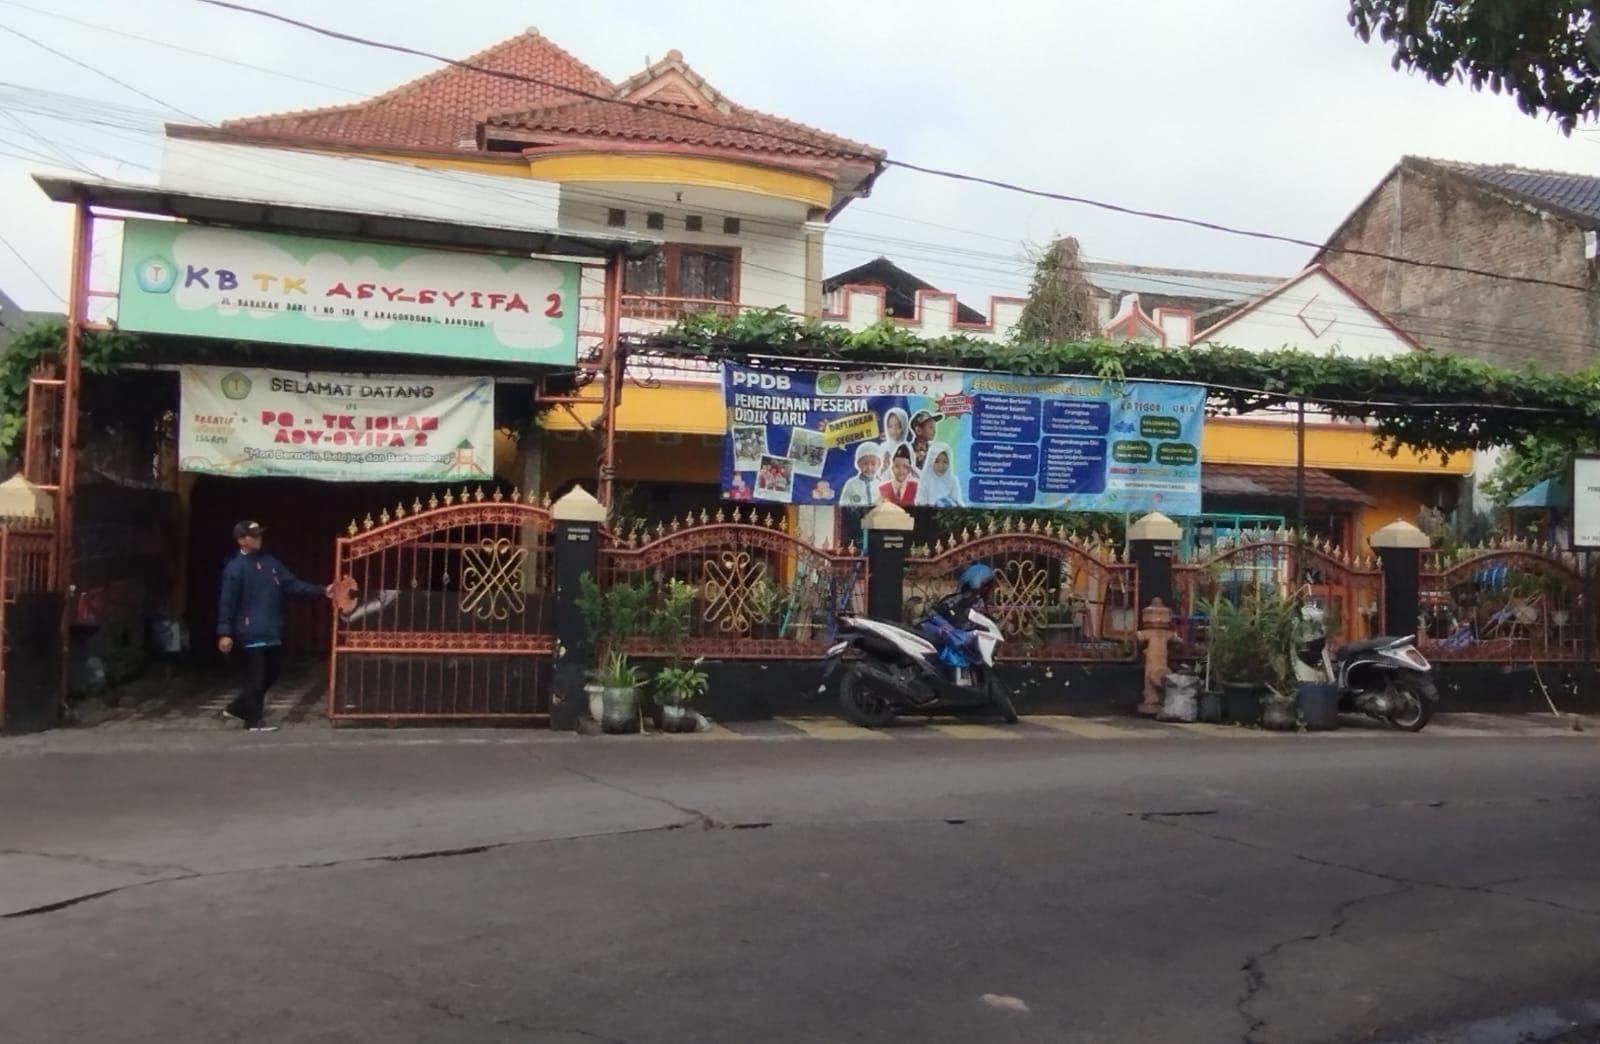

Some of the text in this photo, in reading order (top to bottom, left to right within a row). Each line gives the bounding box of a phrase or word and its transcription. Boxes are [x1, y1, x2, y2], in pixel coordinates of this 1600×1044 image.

[184, 264, 239, 291] KB
[251, 272, 308, 295] TK
[544, 293, 563, 319] 2
[733, 371, 792, 390] PPDB
[902, 370, 944, 382] ISLAM
[271, 377, 435, 399] SELAMAT DATANG
[845, 384, 929, 395] ASY-SYIFA 2
[734, 393, 869, 412] PENERIMAAN PESERTA
[322, 414, 356, 431] TK
[365, 415, 439, 431] ISLAM
[735, 407, 807, 426] DIDIK BARU
[415, 432, 428, 447] 2
